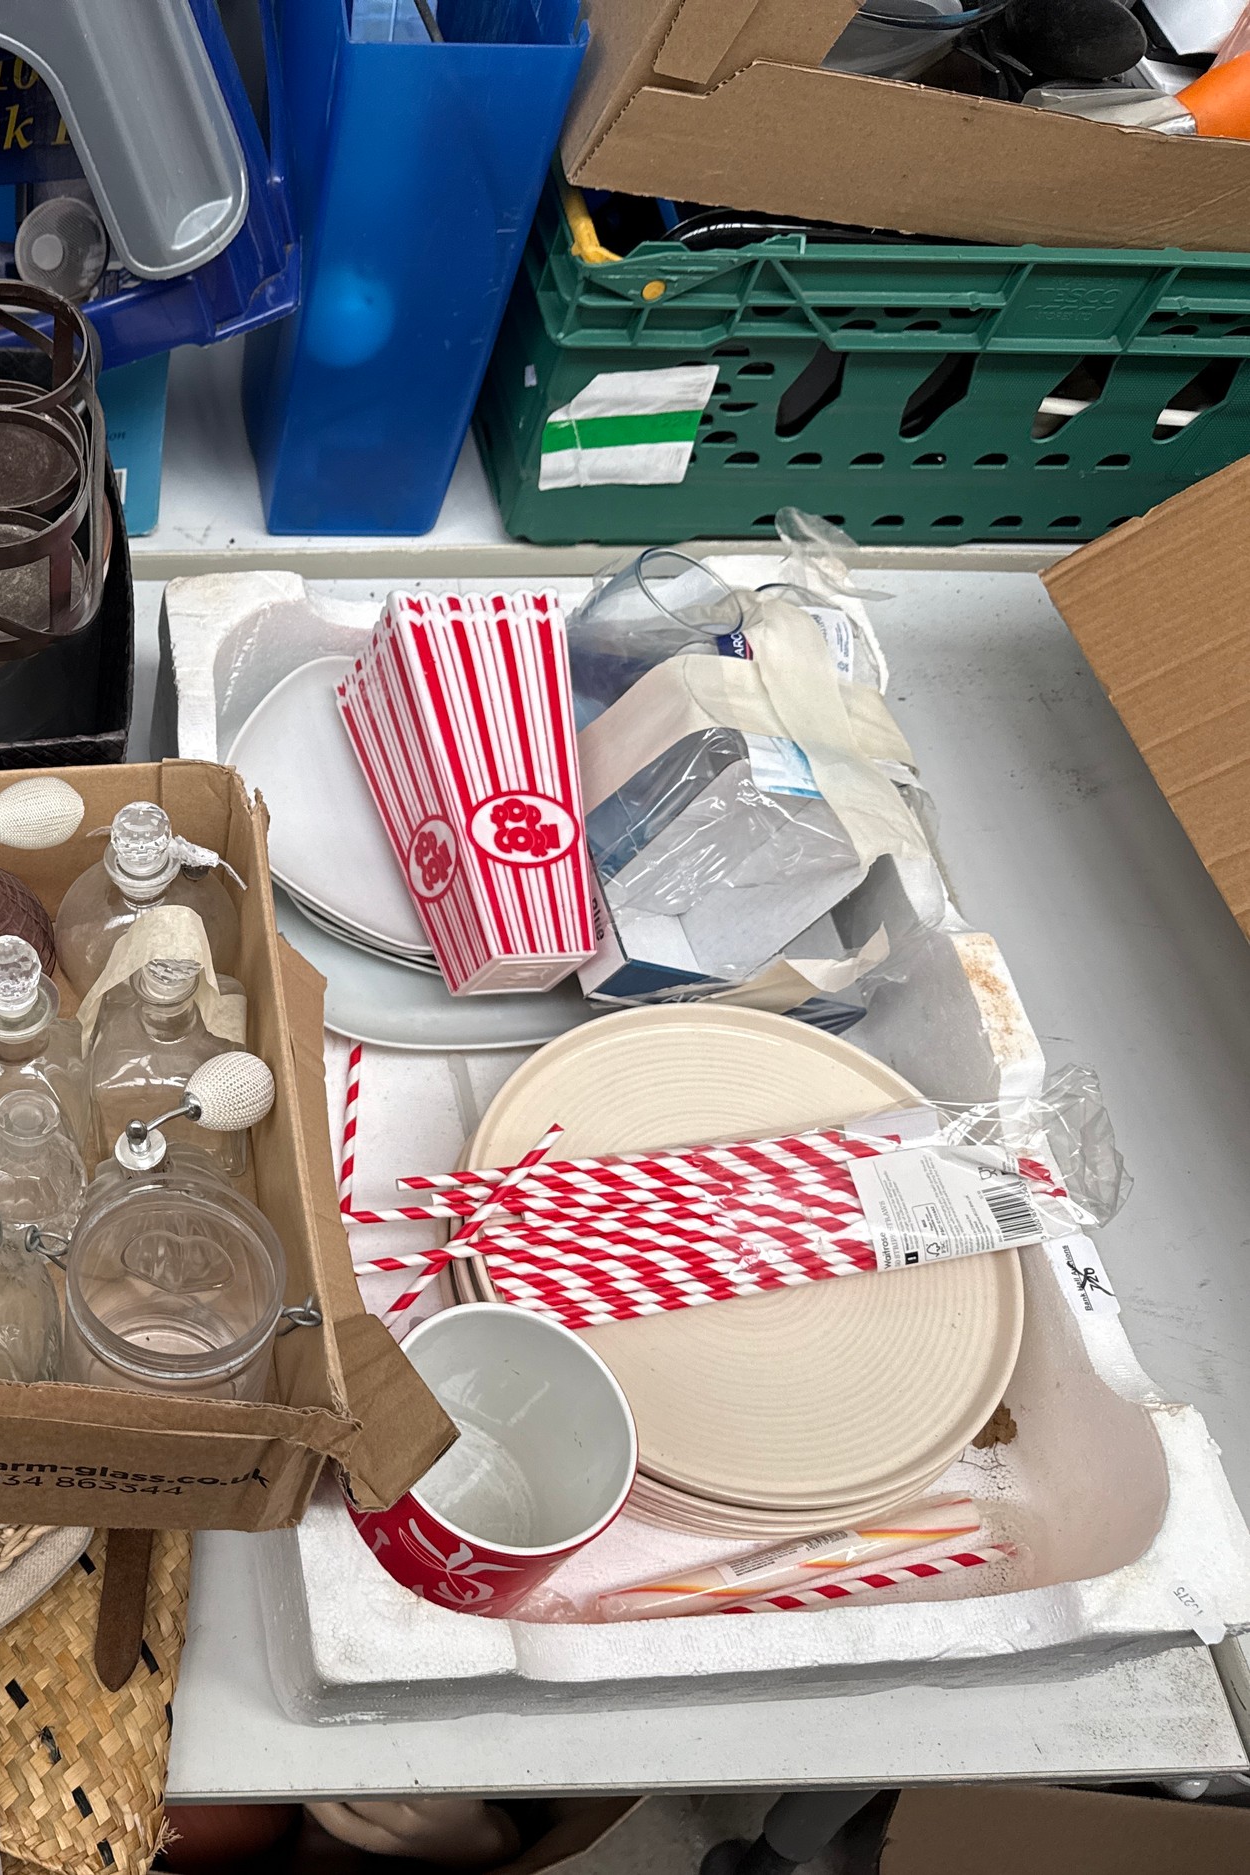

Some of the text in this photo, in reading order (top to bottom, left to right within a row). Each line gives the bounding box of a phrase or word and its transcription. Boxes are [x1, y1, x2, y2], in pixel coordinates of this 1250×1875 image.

[1035, 287, 1122, 304] TESCO
[490, 798, 542, 829] POP
[494, 823, 561, 857] CORN
[880, 1232, 892, 1270] Waitrose
[1080, 1291, 1094, 1312] Bank
[55, 1476, 184, 1496] 863344
